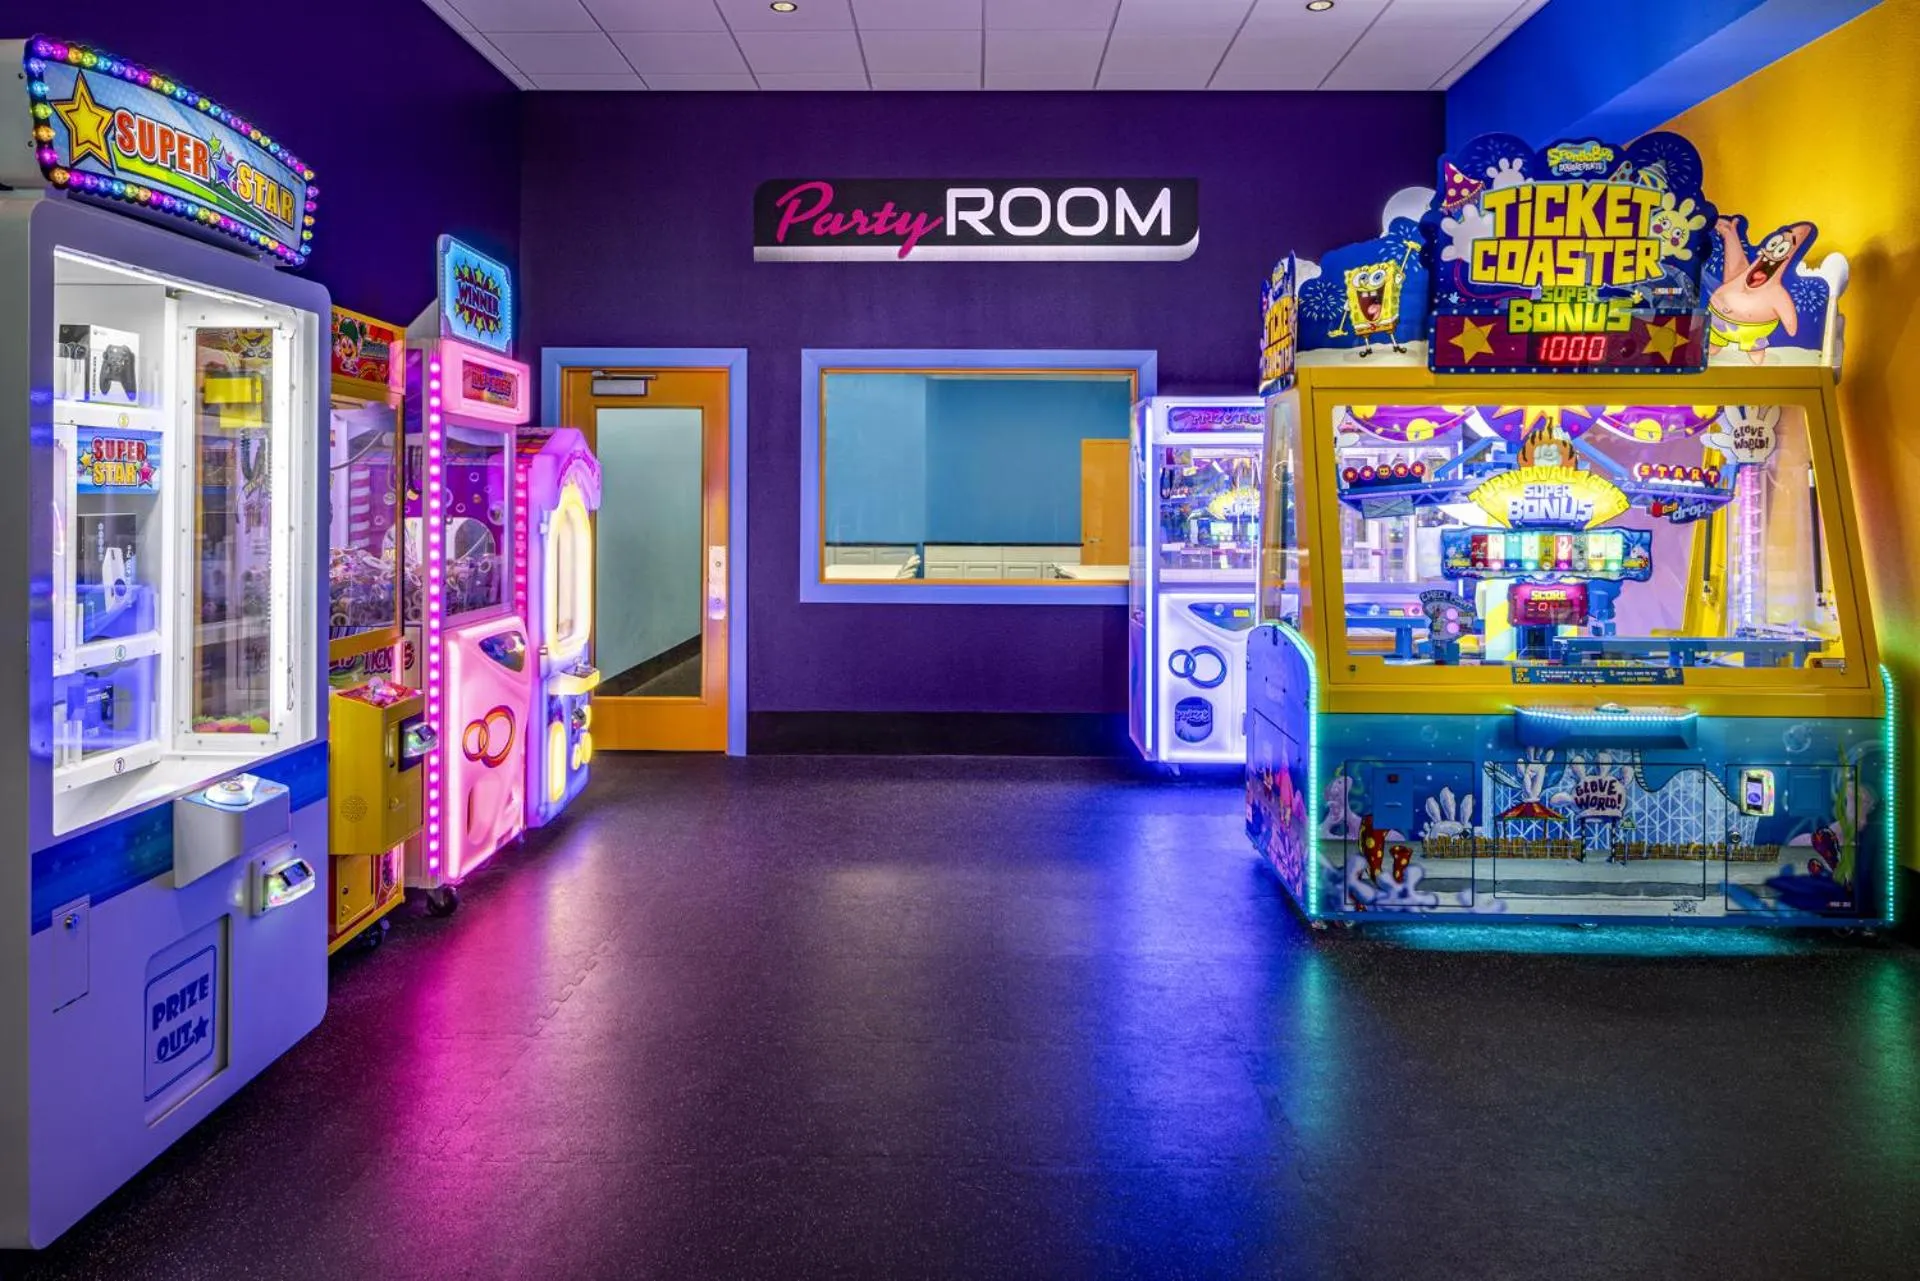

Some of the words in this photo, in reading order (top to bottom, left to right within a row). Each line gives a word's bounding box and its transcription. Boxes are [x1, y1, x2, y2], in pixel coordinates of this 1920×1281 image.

[114, 109, 210, 181] SUPER
[236, 161, 295, 229] STAR
[775, 181, 944, 258] Party
[946, 187, 1171, 236] ROOM
[1472, 239, 1664, 287] COASTER
[1542, 287, 1599, 302] SUPER
[1509, 298, 1633, 333] BONUS
[1540, 336, 1606, 361] 1000
[92, 437, 147, 461] SUPER
[93, 462, 138, 486] STAR
[1641, 465, 1716, 484] START
[1524, 485, 1572, 497] SUPER
[1508, 497, 1594, 521] BONUS
[1531, 590, 1567, 600] SCORE
[1576, 779, 1617, 797] GLOVE
[1575, 794, 1622, 811] WORLD!
[152, 973, 210, 1031] PRIZE
[156, 1021, 193, 1061] OUT
